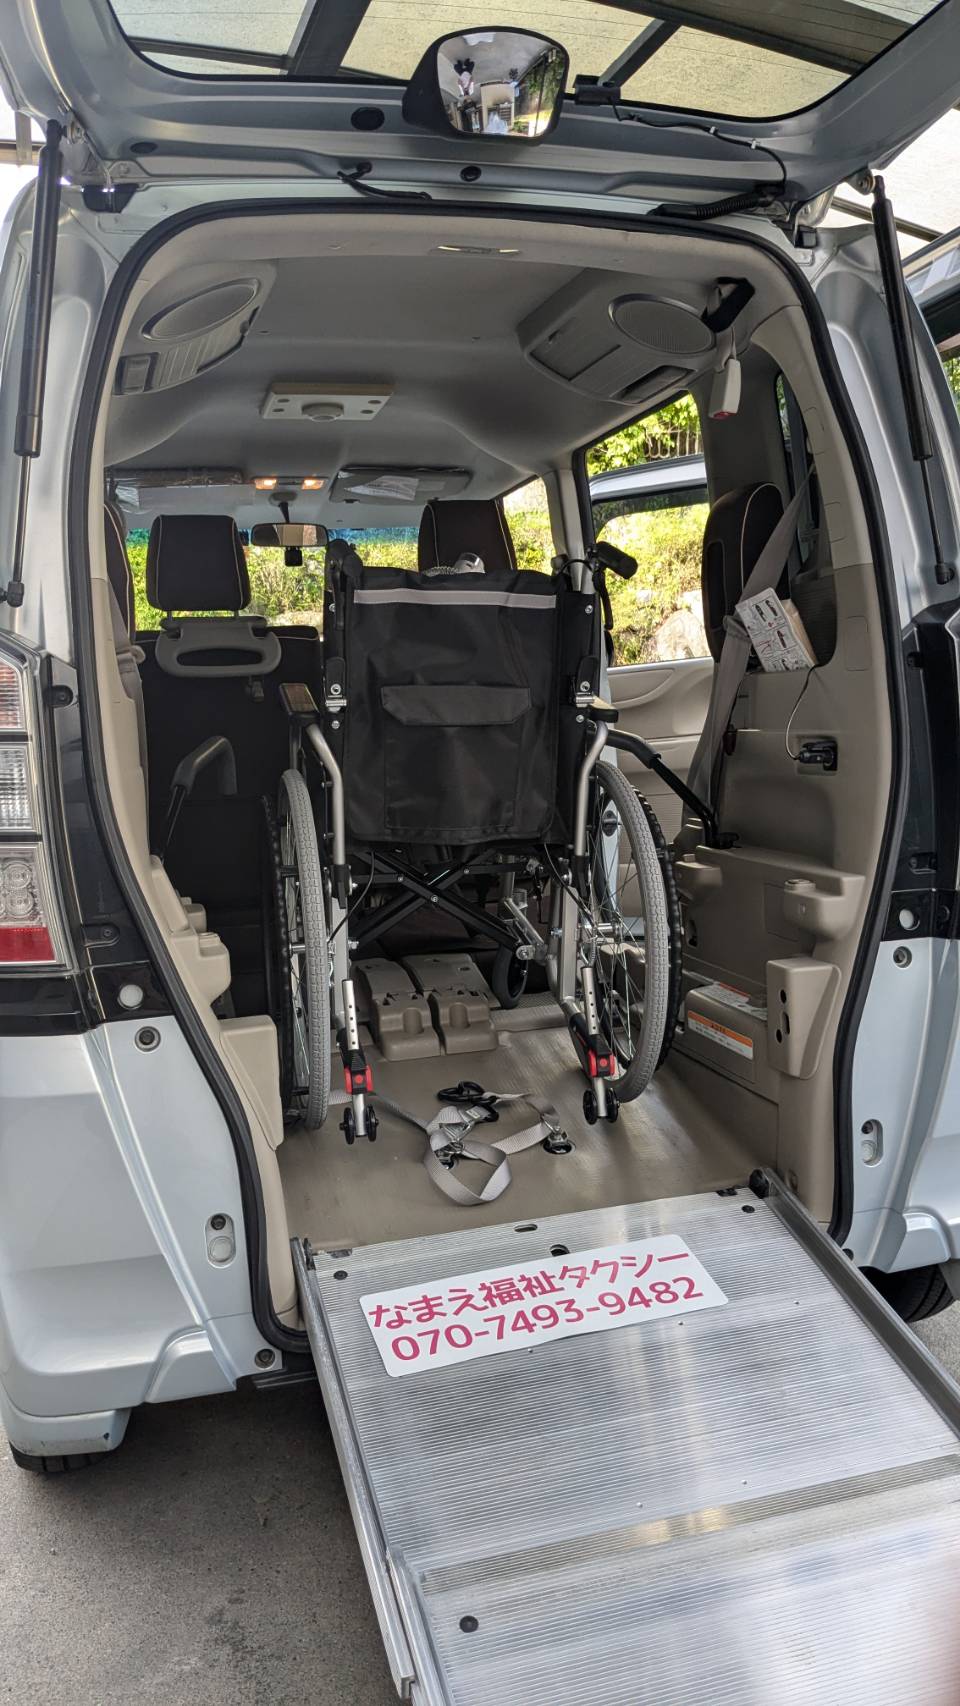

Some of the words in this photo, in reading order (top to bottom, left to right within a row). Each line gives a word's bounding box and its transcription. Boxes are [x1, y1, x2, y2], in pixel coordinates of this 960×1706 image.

[368, 1252, 689, 1330] なまえ福祉タクシー
[391, 1276, 704, 1361] 070-7493-9482
